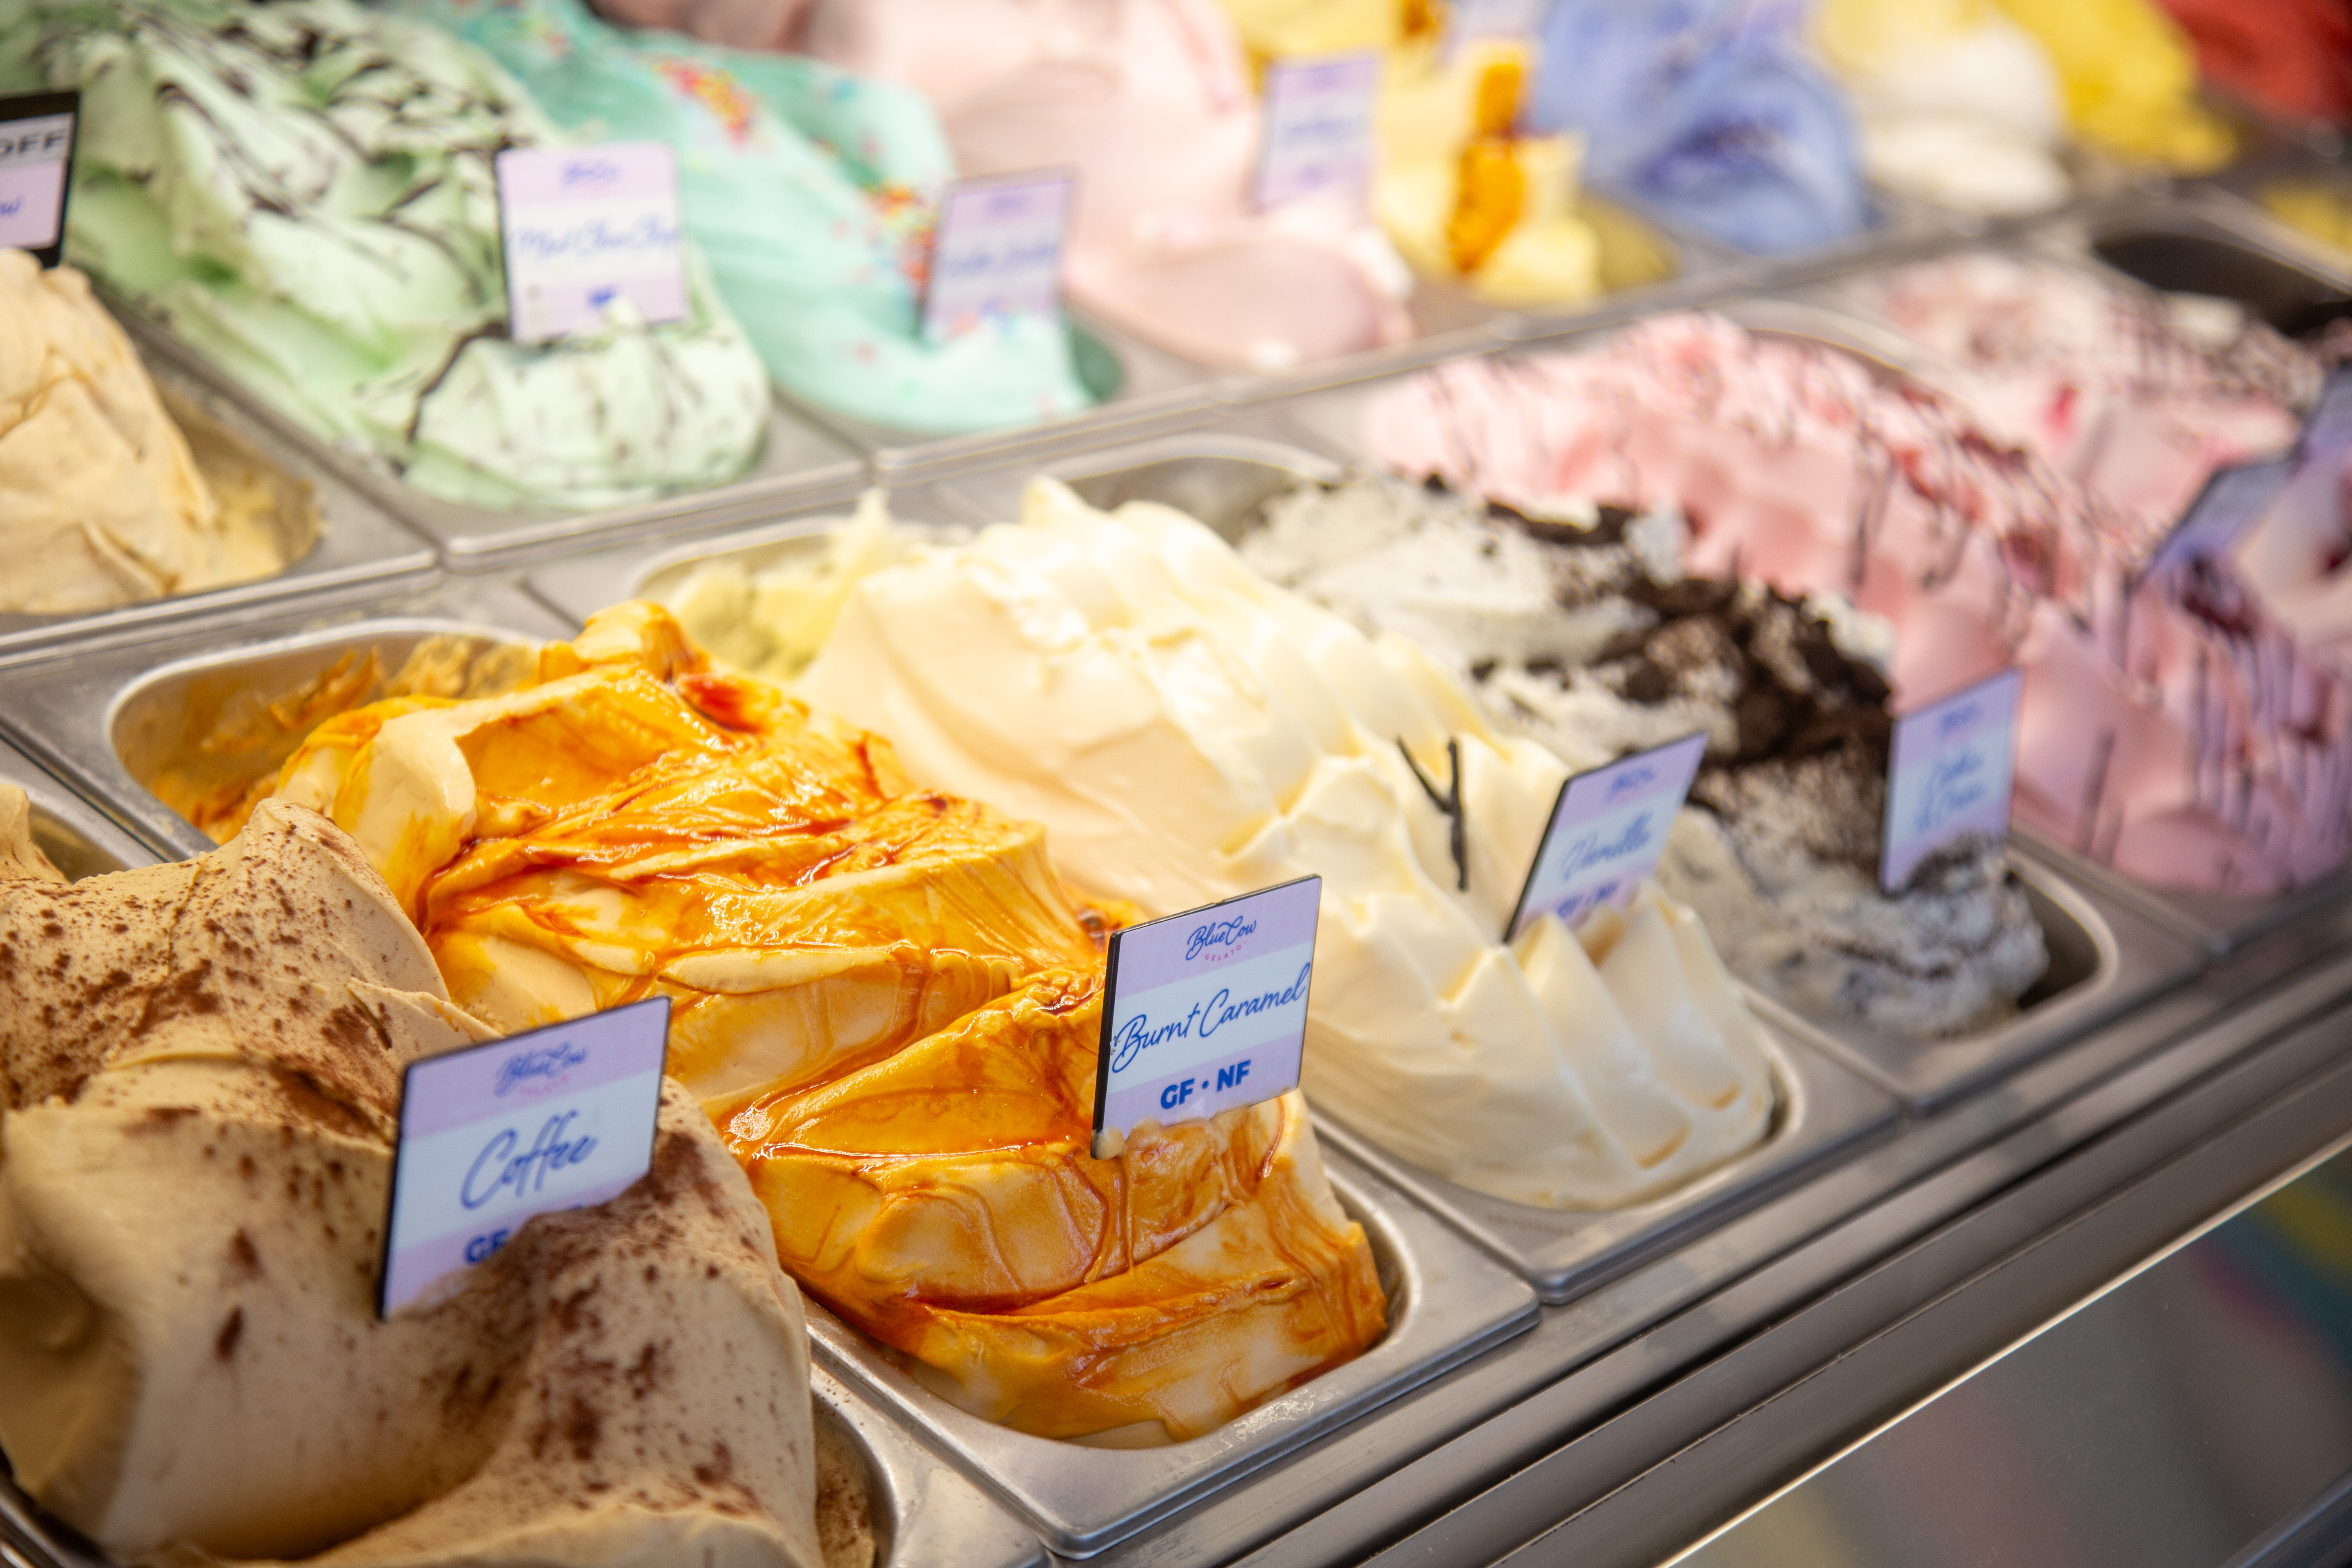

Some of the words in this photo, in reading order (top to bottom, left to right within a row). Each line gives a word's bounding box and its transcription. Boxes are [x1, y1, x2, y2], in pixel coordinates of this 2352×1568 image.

[1205, 944, 1242, 961] GELATO
[1112, 1002, 1200, 1073] Burnt
[1199, 962, 1311, 1038] Caramel
[1160, 1078, 1195, 1110] GF
[1216, 1060, 1252, 1093] NF
[461, 1110, 599, 1209] Coffee
